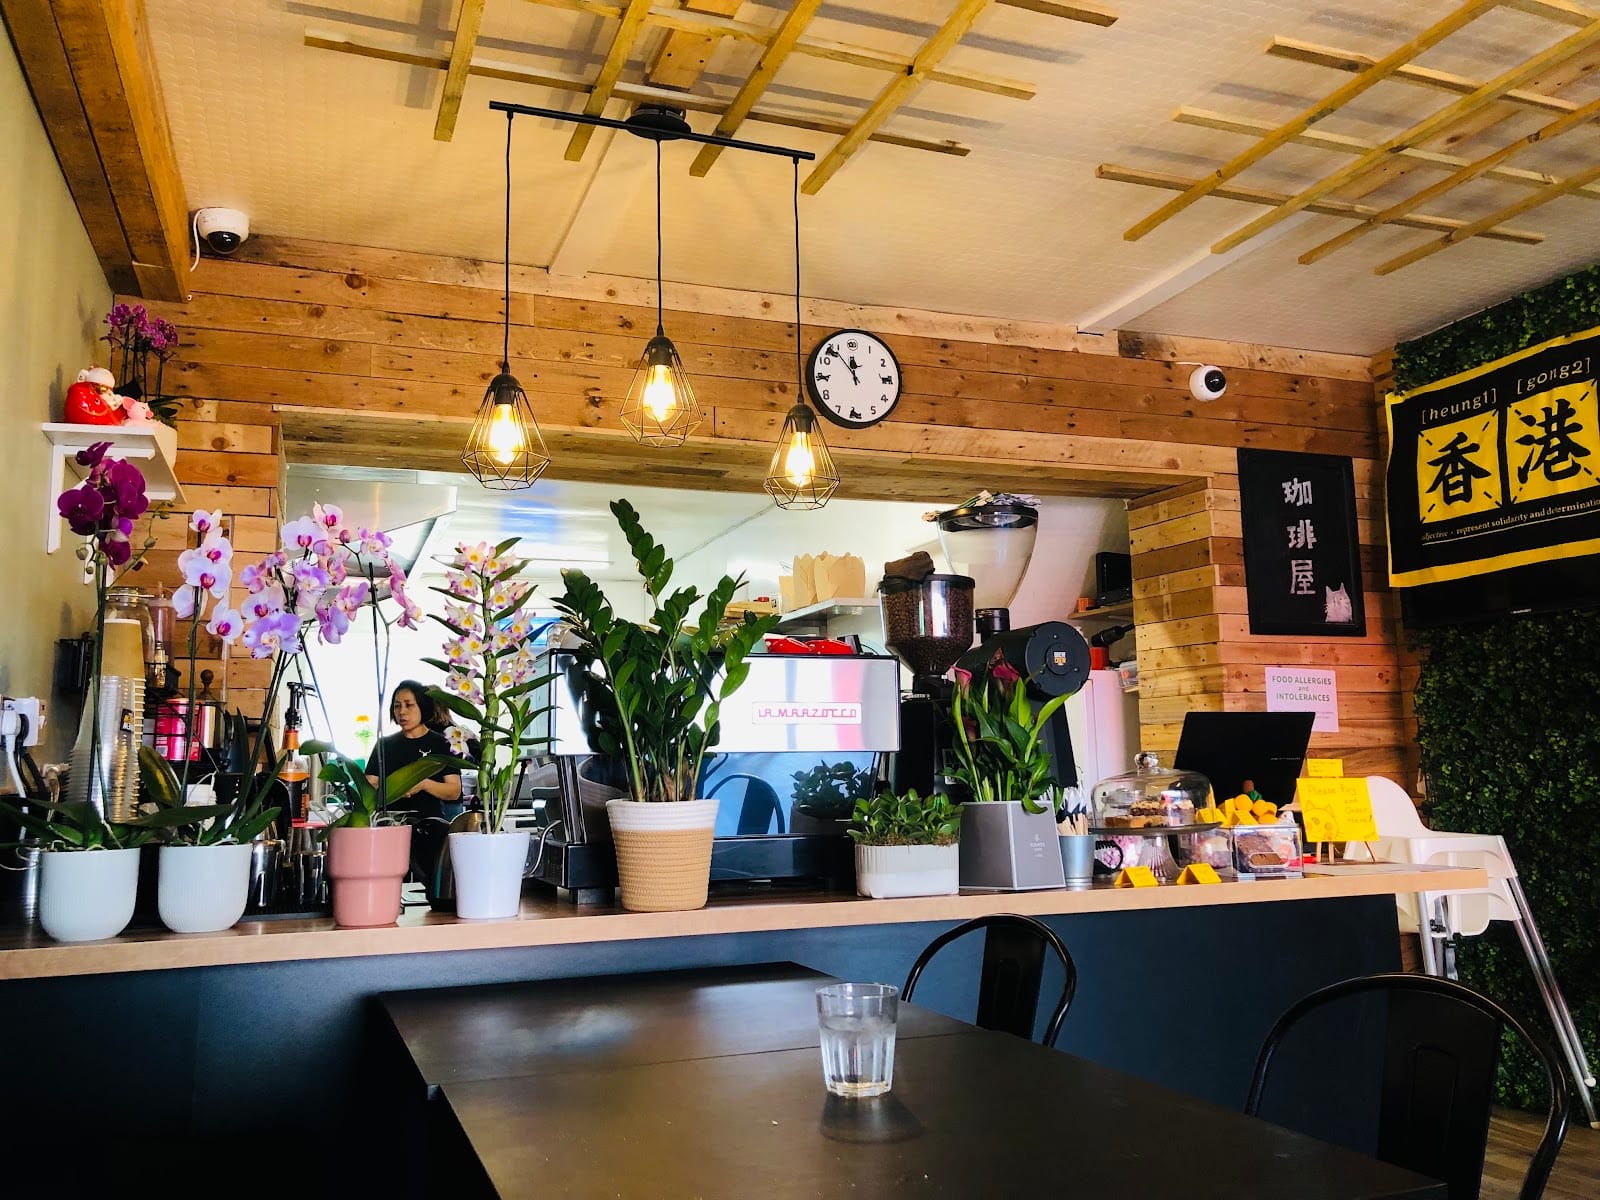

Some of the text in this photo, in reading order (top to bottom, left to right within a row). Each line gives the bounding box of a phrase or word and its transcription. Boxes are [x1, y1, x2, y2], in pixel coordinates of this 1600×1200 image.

[819, 356, 831, 365] 10
[880, 358, 886, 367] 2
[822, 390, 830, 400] 8
[1421, 357, 1591, 424] [heung1] [gong2]
[880, 395, 889, 403] 4
[835, 405, 841, 414] 7
[871, 406, 876, 415] 5
[1456, 522, 1490, 535] represent
[1492, 513, 1528, 527] solidarity
[1529, 509, 1545, 519] and
[1281, 477, 1317, 595] 珈琲屋
[1272, 675, 1332, 685] FOOD ALLERGIES
[1276, 692, 1330, 702] INTOLERANCES
